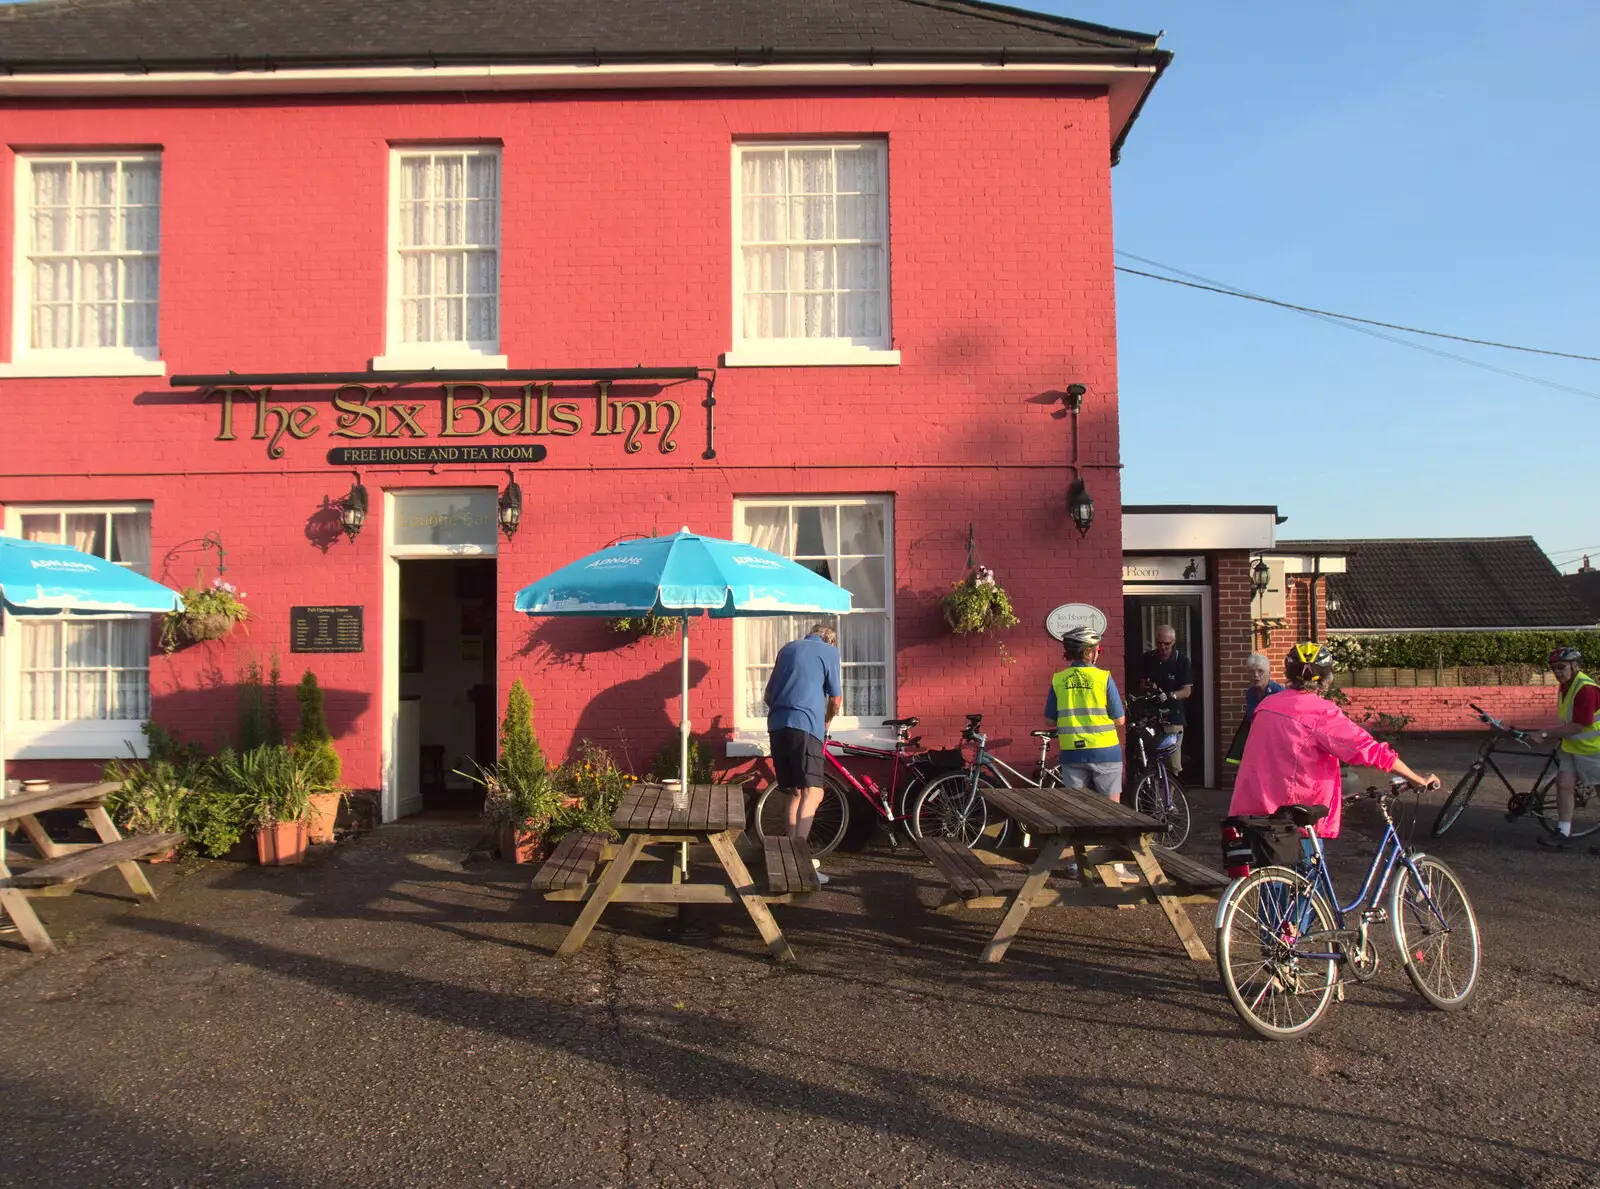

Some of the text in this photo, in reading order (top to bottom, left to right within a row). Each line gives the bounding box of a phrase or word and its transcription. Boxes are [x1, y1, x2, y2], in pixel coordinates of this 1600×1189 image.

[203, 381, 682, 459] The Six Bells Inn
[344, 446, 533, 461] FREE HOUSE AND TEA ROOM
[585, 556, 642, 568] ADNAMS
[1127, 565, 1159, 576] Room
